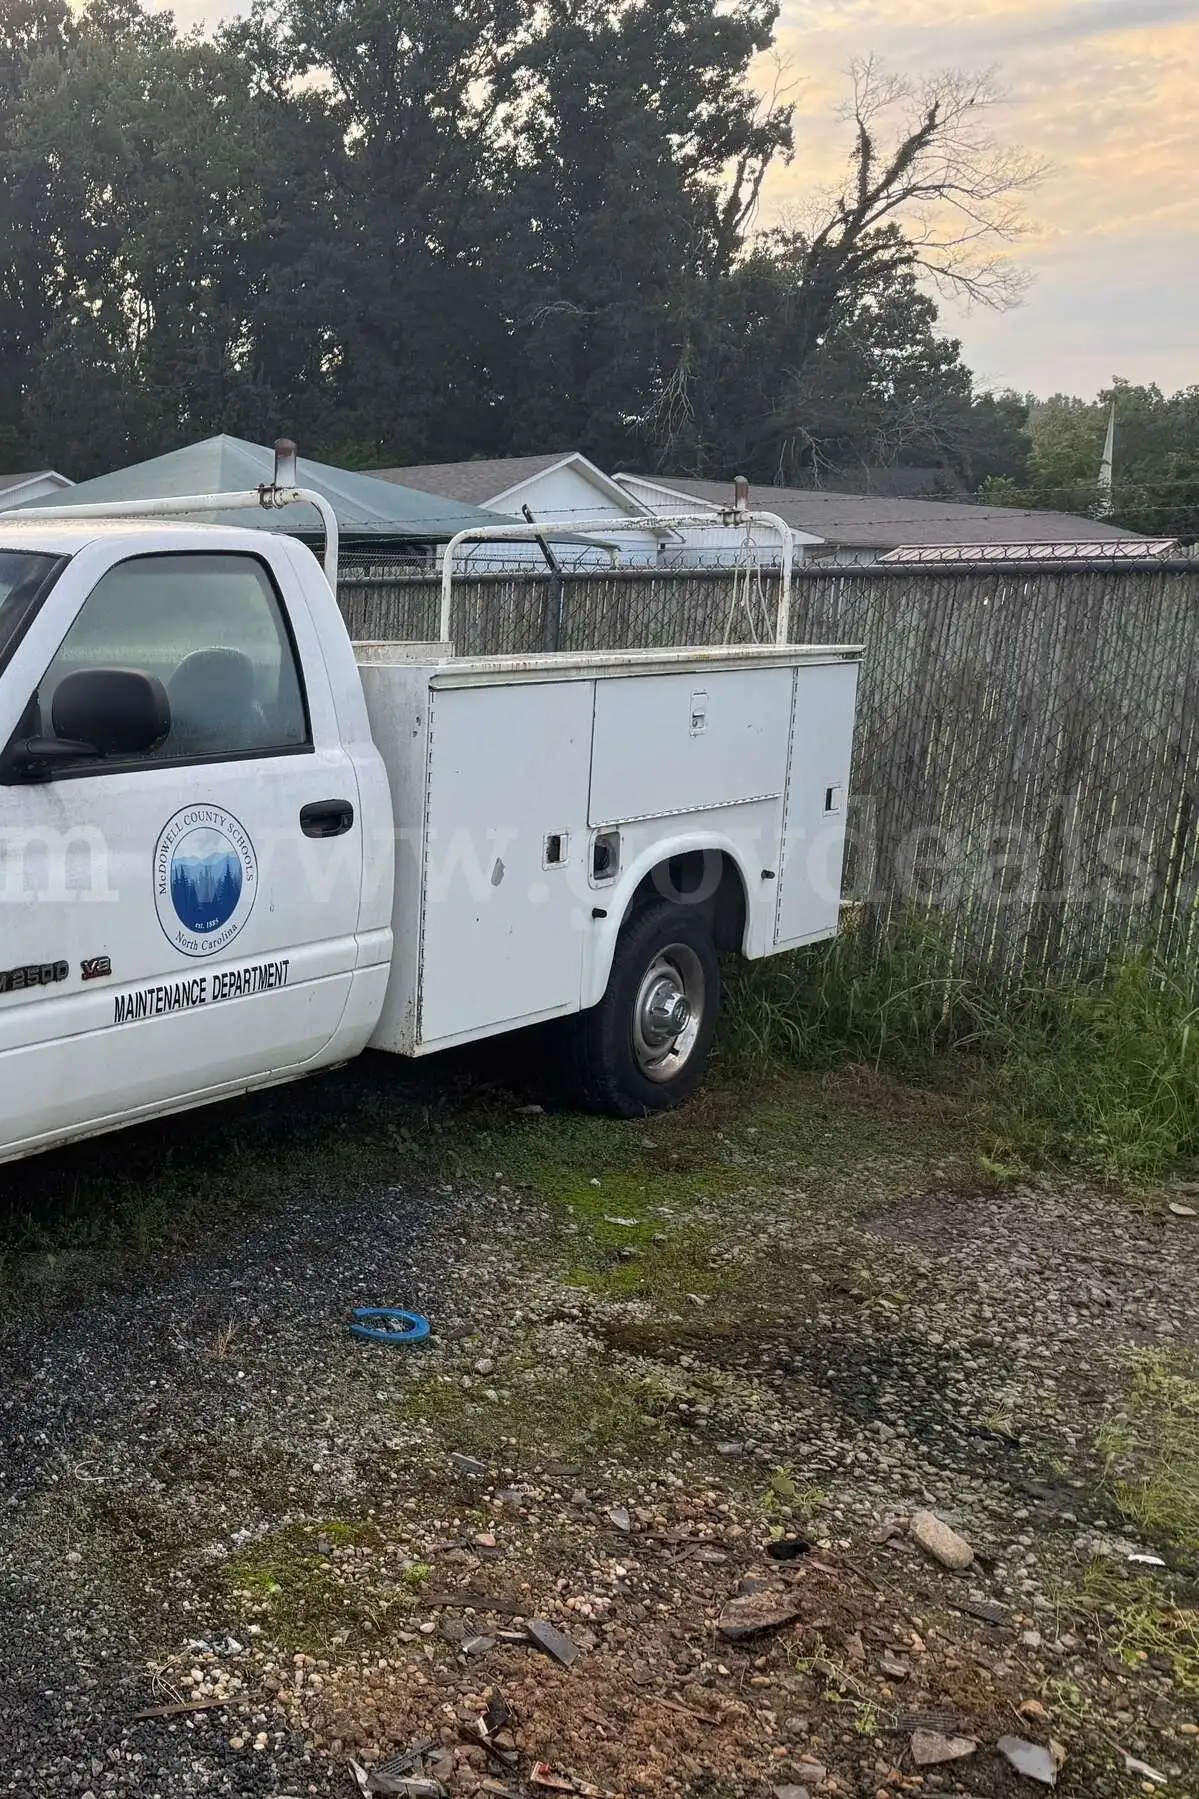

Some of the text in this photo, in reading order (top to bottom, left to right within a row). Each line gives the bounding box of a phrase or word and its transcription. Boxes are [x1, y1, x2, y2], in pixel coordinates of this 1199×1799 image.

[158, 810, 254, 895] McDOWELL COUNTY SCHOOLS
[175, 924, 238, 951] North Carolina
[9, 959, 70, 990] 2500
[114, 959, 290, 1023] MAINTENANCE DEPARTMENT
